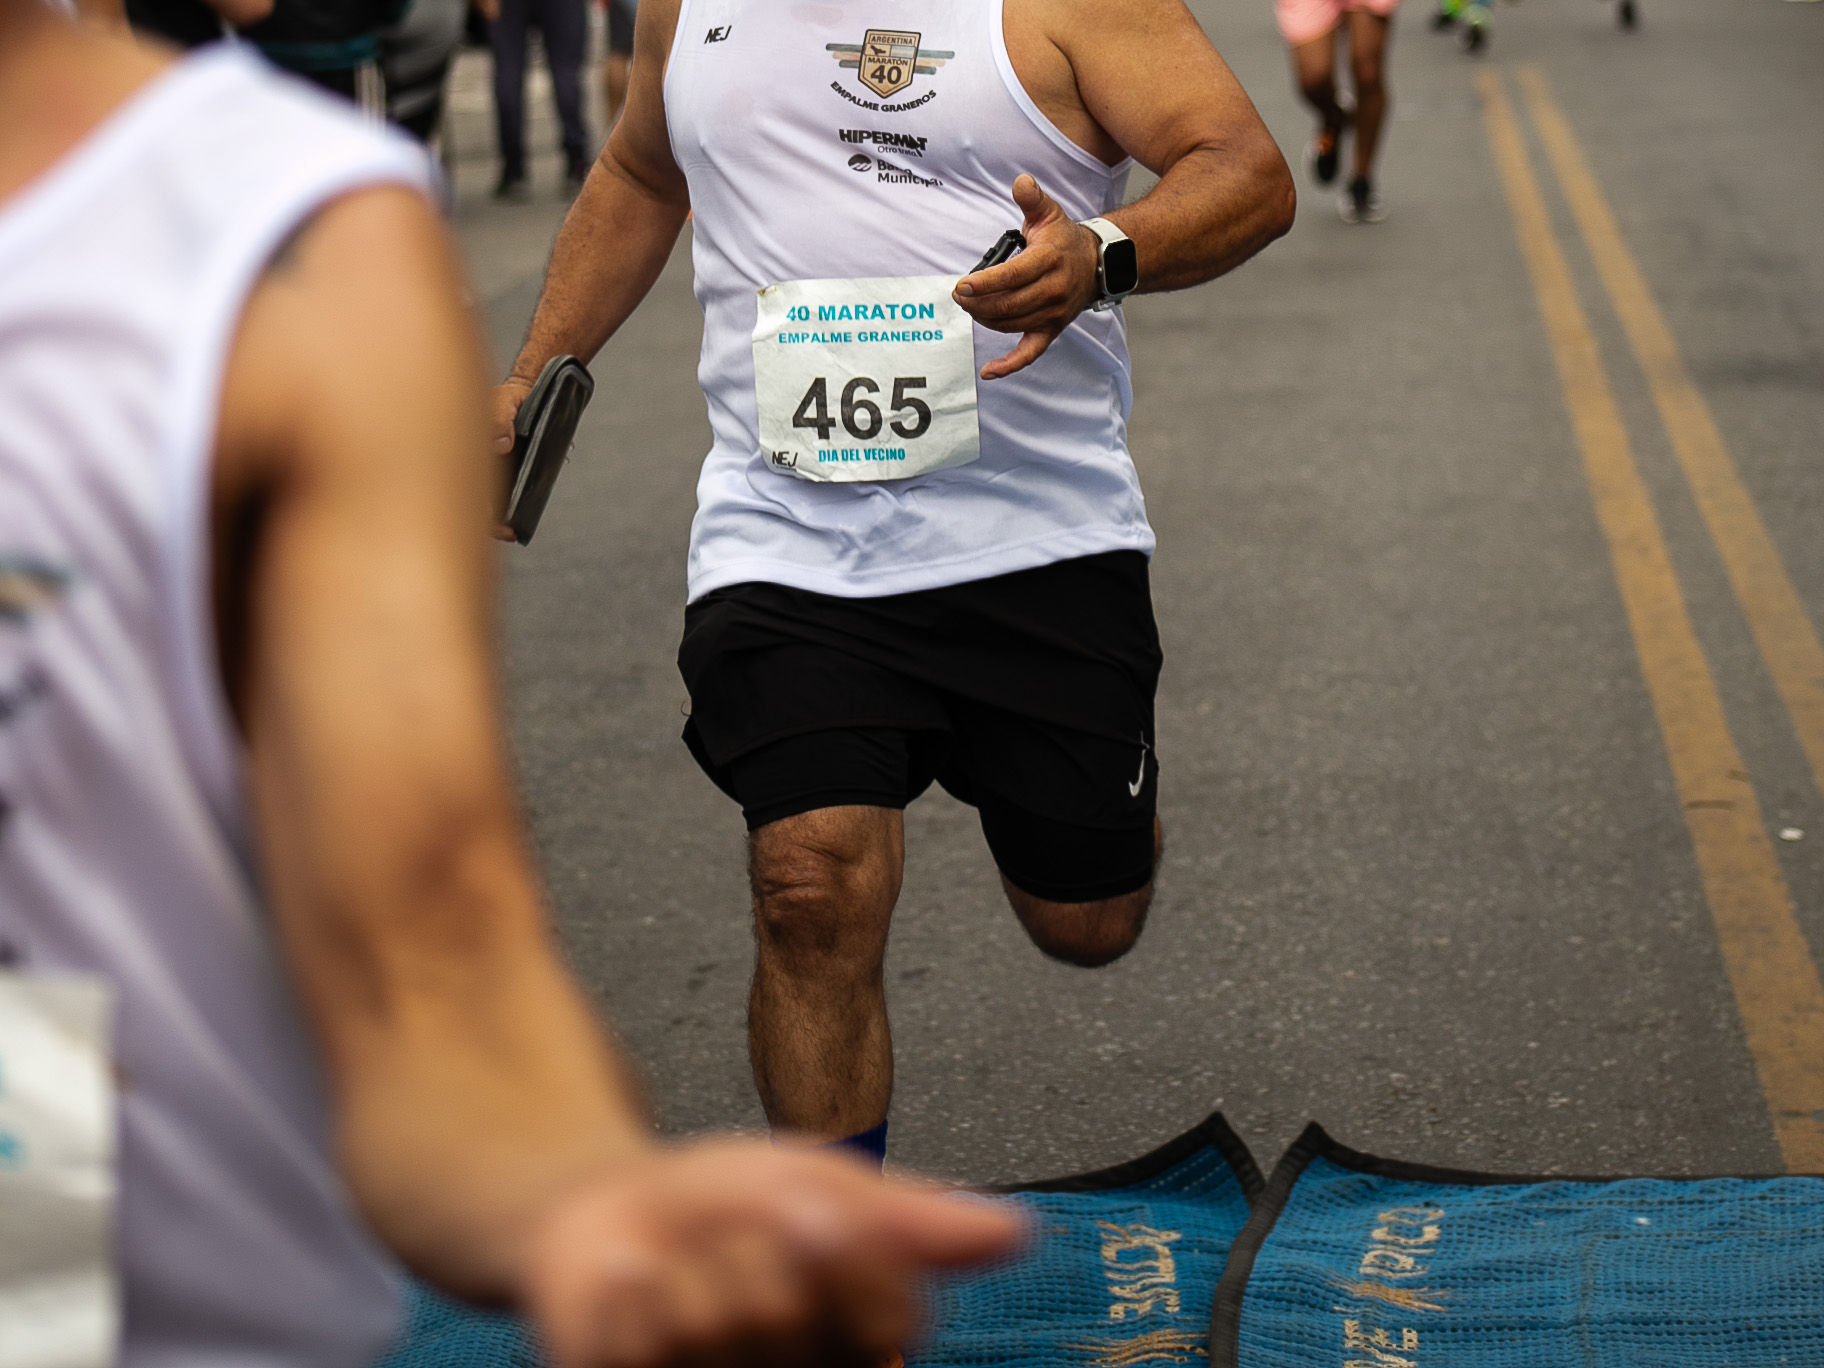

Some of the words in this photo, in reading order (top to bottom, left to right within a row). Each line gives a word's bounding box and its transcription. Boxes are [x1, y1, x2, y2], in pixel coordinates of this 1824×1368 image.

[704, 25, 732, 44] NEJ
[871, 35, 913, 45] ARGENTINA
[870, 65, 901, 84] 40
[830, 81, 879, 111] EMPALME
[881, 89, 936, 112] GRANEROS
[877, 145, 897, 153] Otro
[786, 306, 810, 322] 40
[818, 303, 935, 321] MARATON
[778, 332, 852, 344] EMPALME
[857, 330, 944, 342] GRANEROS
[792, 377, 932, 440] 465
[772, 451, 798, 467] NEJ
[818, 449, 839, 462] DIA
[841, 449, 861, 461] DEL
[863, 448, 906, 461] VECINO
